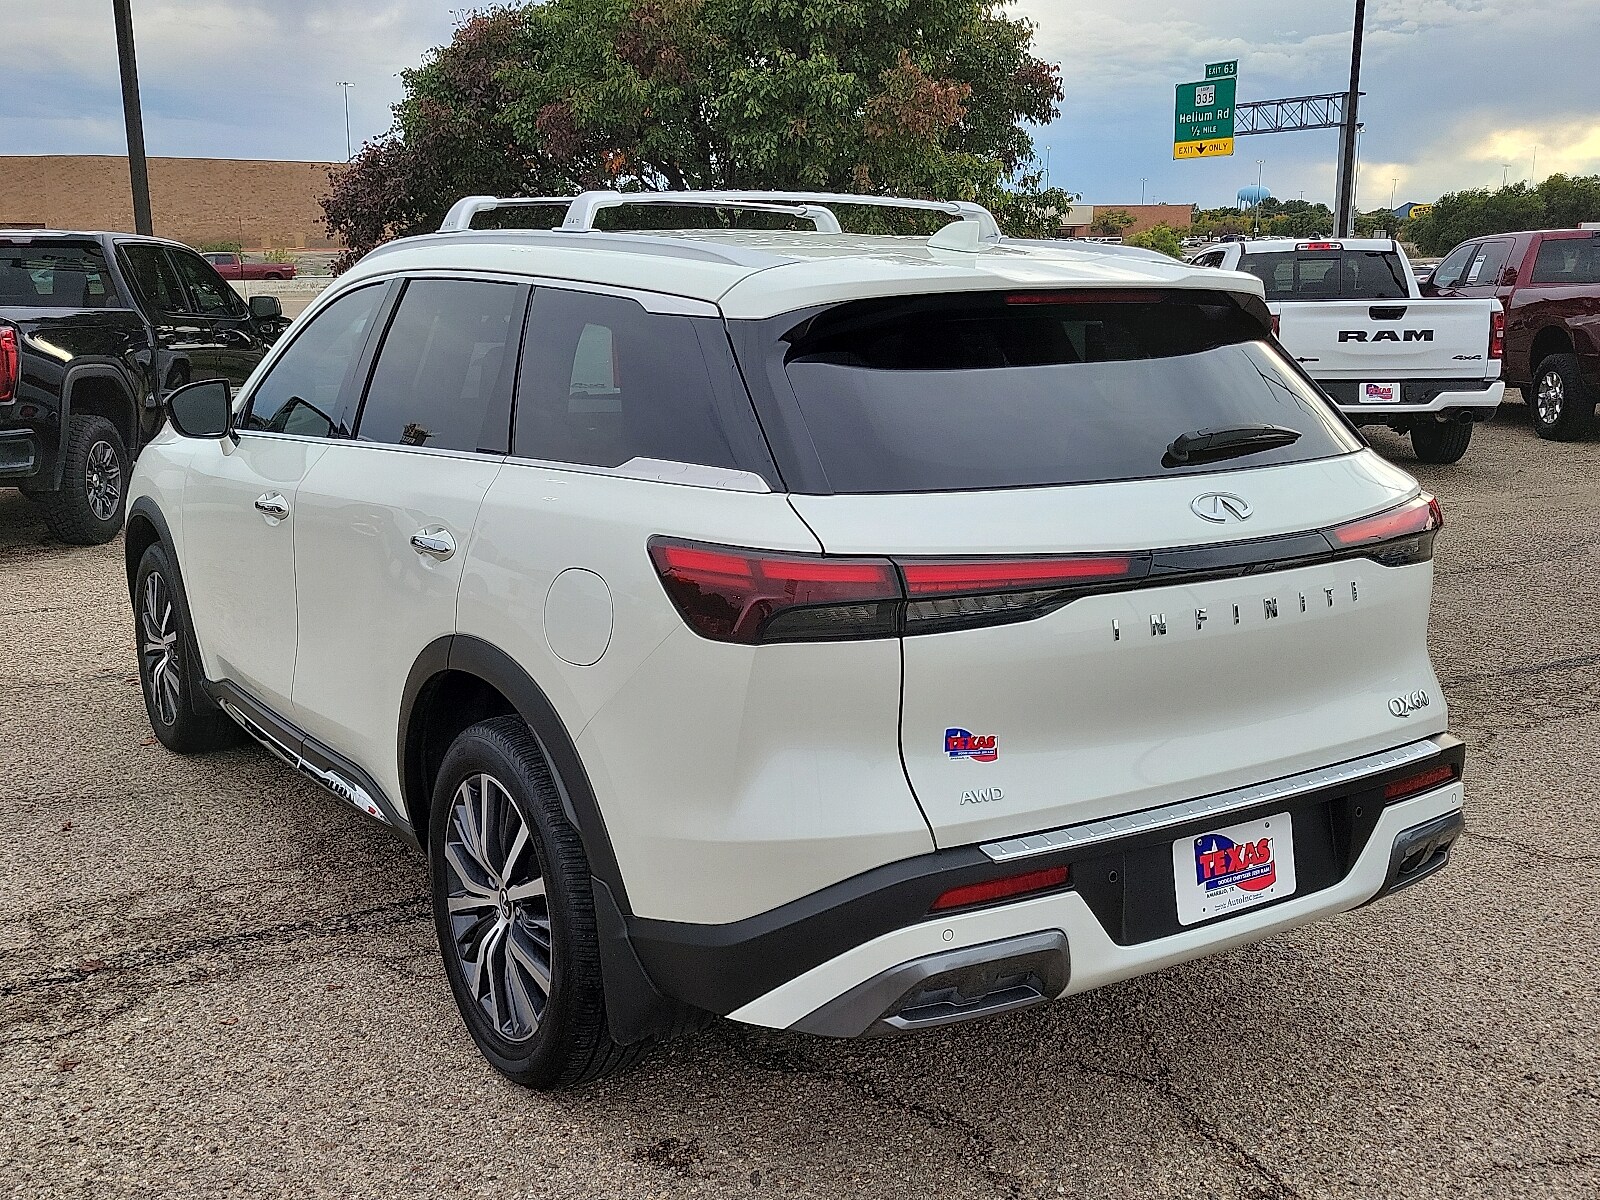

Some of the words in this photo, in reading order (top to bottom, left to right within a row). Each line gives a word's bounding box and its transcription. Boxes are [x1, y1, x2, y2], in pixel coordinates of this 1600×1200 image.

[1208, 67, 1222, 75] EXIT
[1223, 63, 1235, 74] 63
[1196, 92, 1214, 105] 335
[1179, 111, 1213, 124] Helium
[1217, 108, 1230, 120] Rd
[1203, 125, 1217, 134] MILE
[1179, 145, 1193, 154] EXIT
[1208, 142, 1228, 152] ONLY
[1337, 329, 1434, 343] RAM
[1367, 386, 1392, 395] TEXAS
[1112, 580, 1360, 642] INFINITI
[1387, 688, 1431, 719] QX60
[947, 735, 996, 750] TEXAS
[959, 787, 1004, 806] AWD
[1200, 838, 1270, 878] TEXAS
[1218, 877, 1232, 885] DODGE
